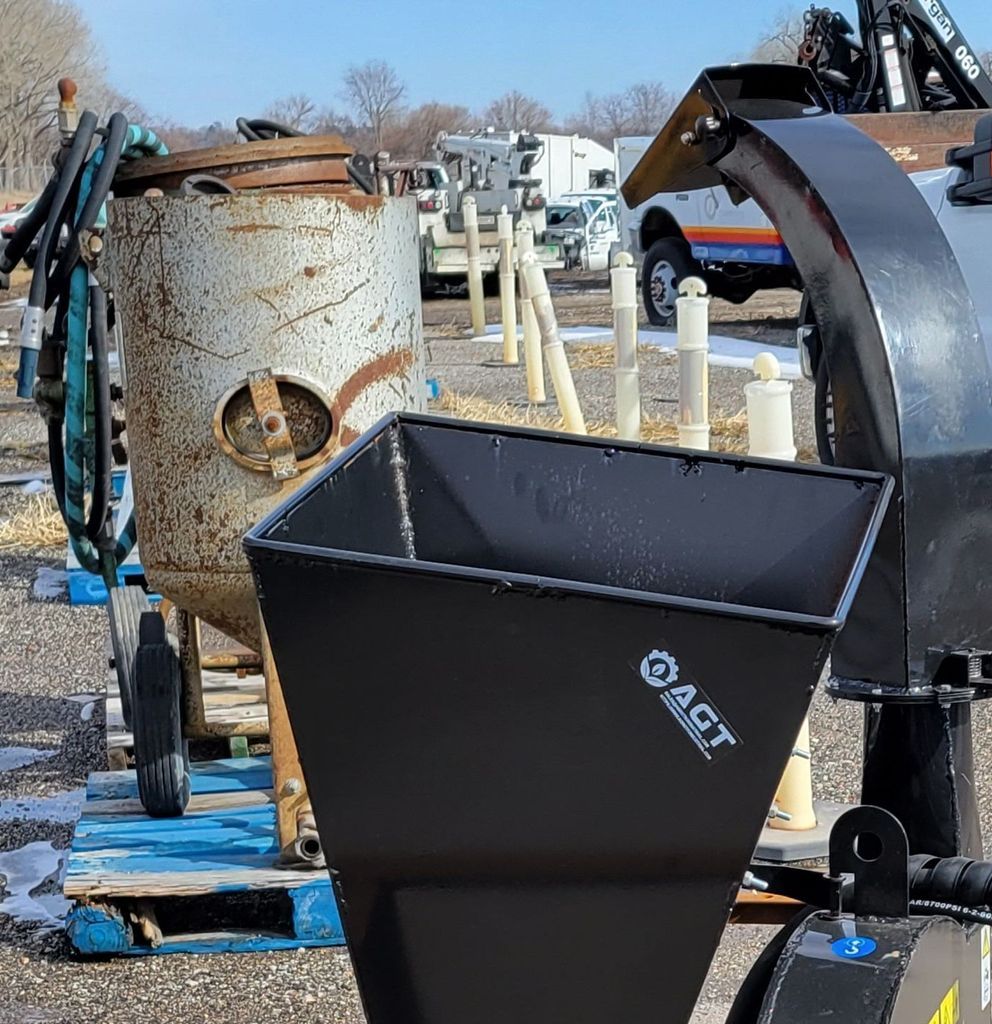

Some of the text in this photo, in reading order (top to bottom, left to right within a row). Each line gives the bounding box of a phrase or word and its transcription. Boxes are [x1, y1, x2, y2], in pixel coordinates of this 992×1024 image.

[924, 0, 952, 36] gan
[955, 45, 980, 80] 060
[669, 684, 737, 748] AGT
